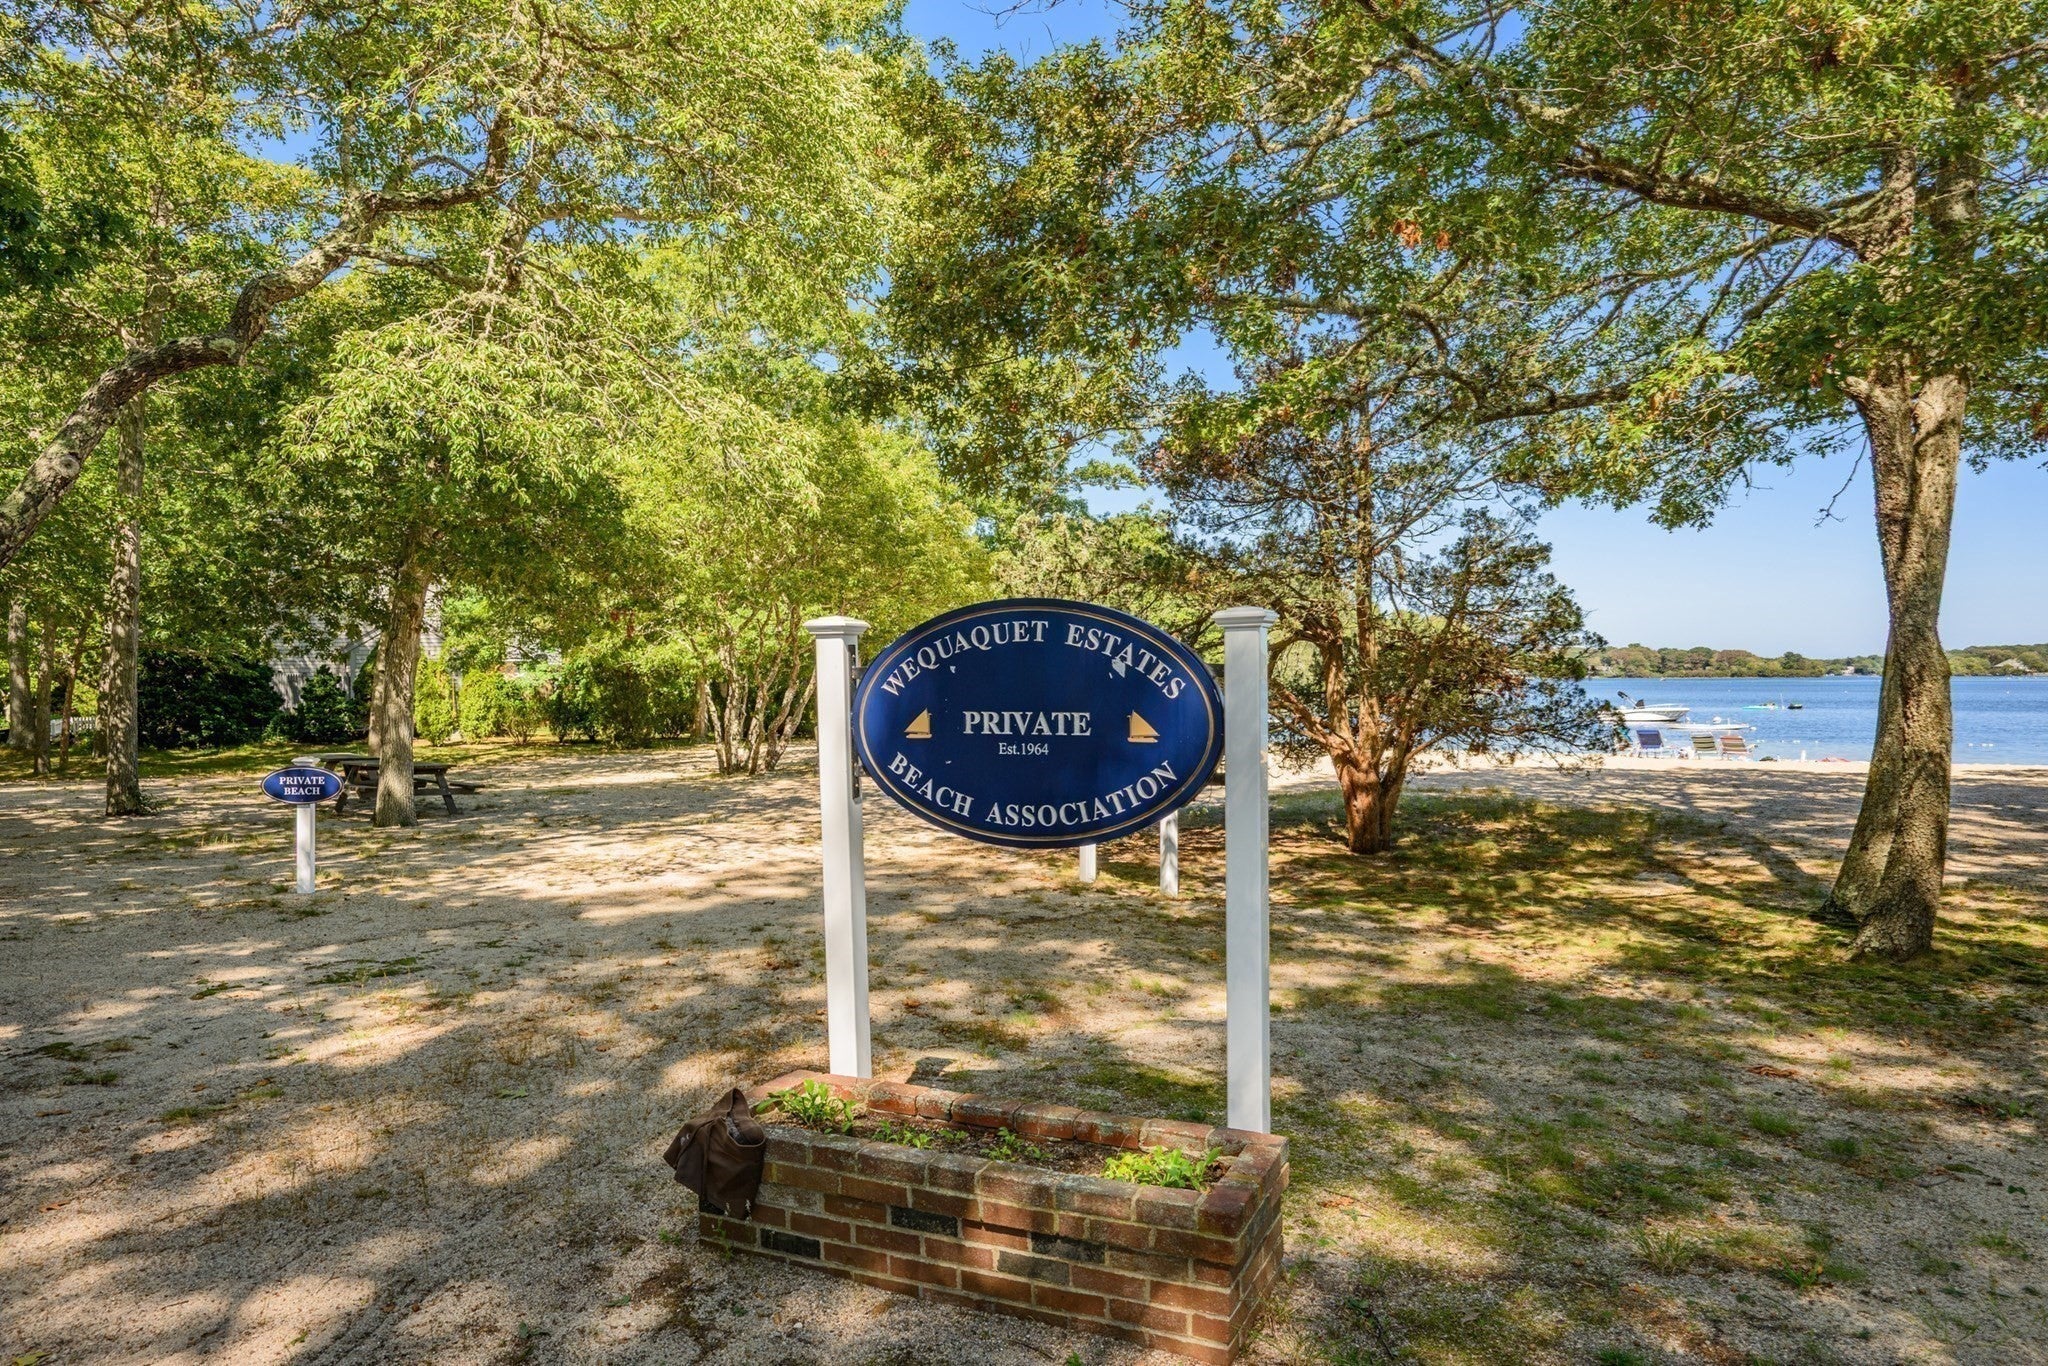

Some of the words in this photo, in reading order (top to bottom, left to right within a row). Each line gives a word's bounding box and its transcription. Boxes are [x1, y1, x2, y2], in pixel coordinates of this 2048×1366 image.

[881, 620, 1049, 697] WEQUAQUET
[1065, 623, 1186, 699] ESTATES
[963, 711, 1091, 737] PRIVATE
[998, 742, 1049, 756] Est.1964
[279, 776, 325, 785] PRIVATE
[887, 752, 975, 818] BEACH
[985, 760, 1179, 828] ASSOCIATION
[284, 787, 320, 796] BEACH
